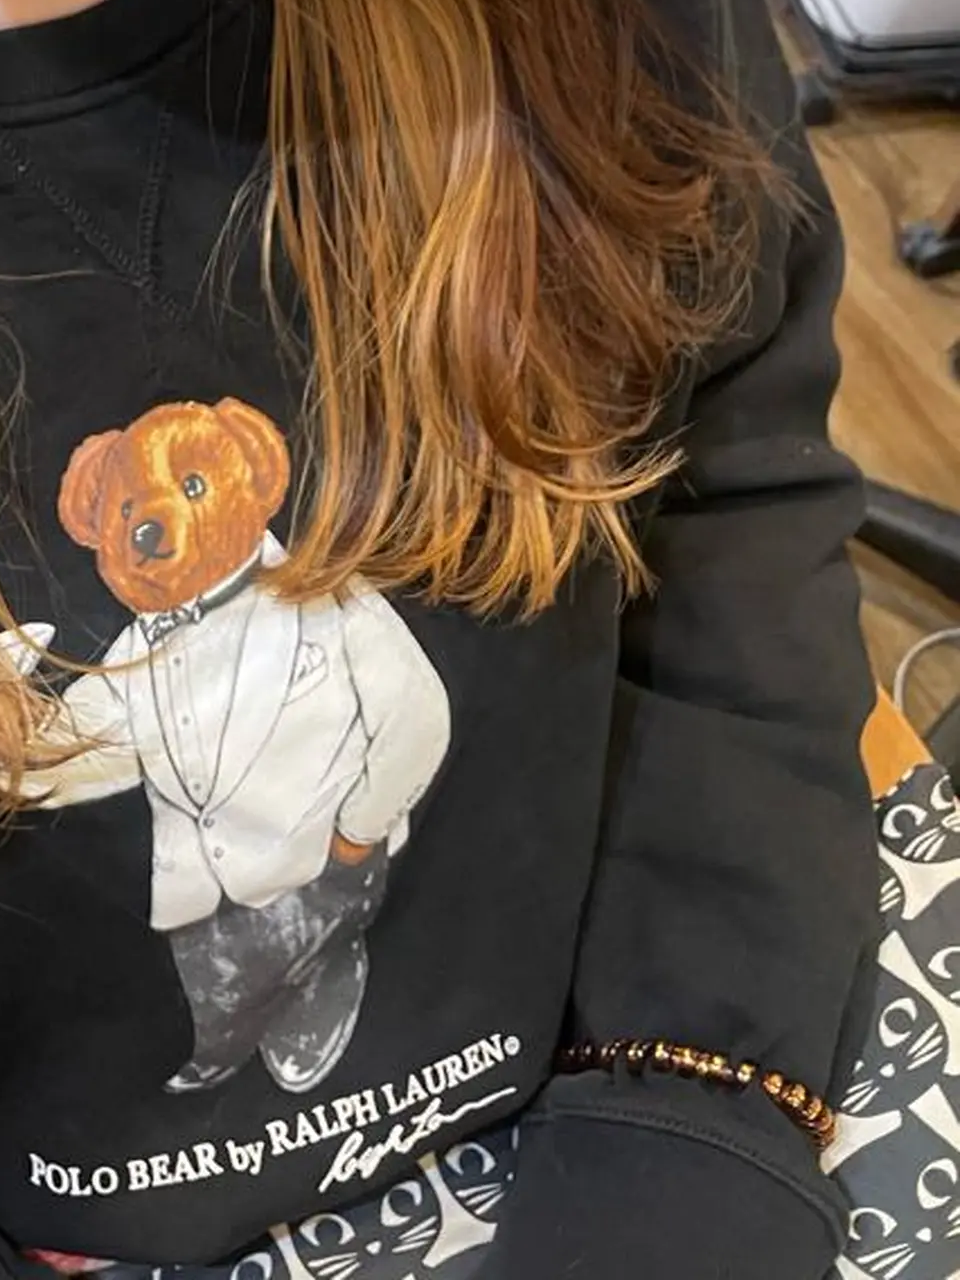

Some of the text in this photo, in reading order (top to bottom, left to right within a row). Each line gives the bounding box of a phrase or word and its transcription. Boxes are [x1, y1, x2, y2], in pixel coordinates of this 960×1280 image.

[29, 1153, 119, 1196] POLO
[127, 1142, 224, 1191] BEAR
[226, 1139, 265, 1175] by
[266, 1090, 381, 1156] RALPH
